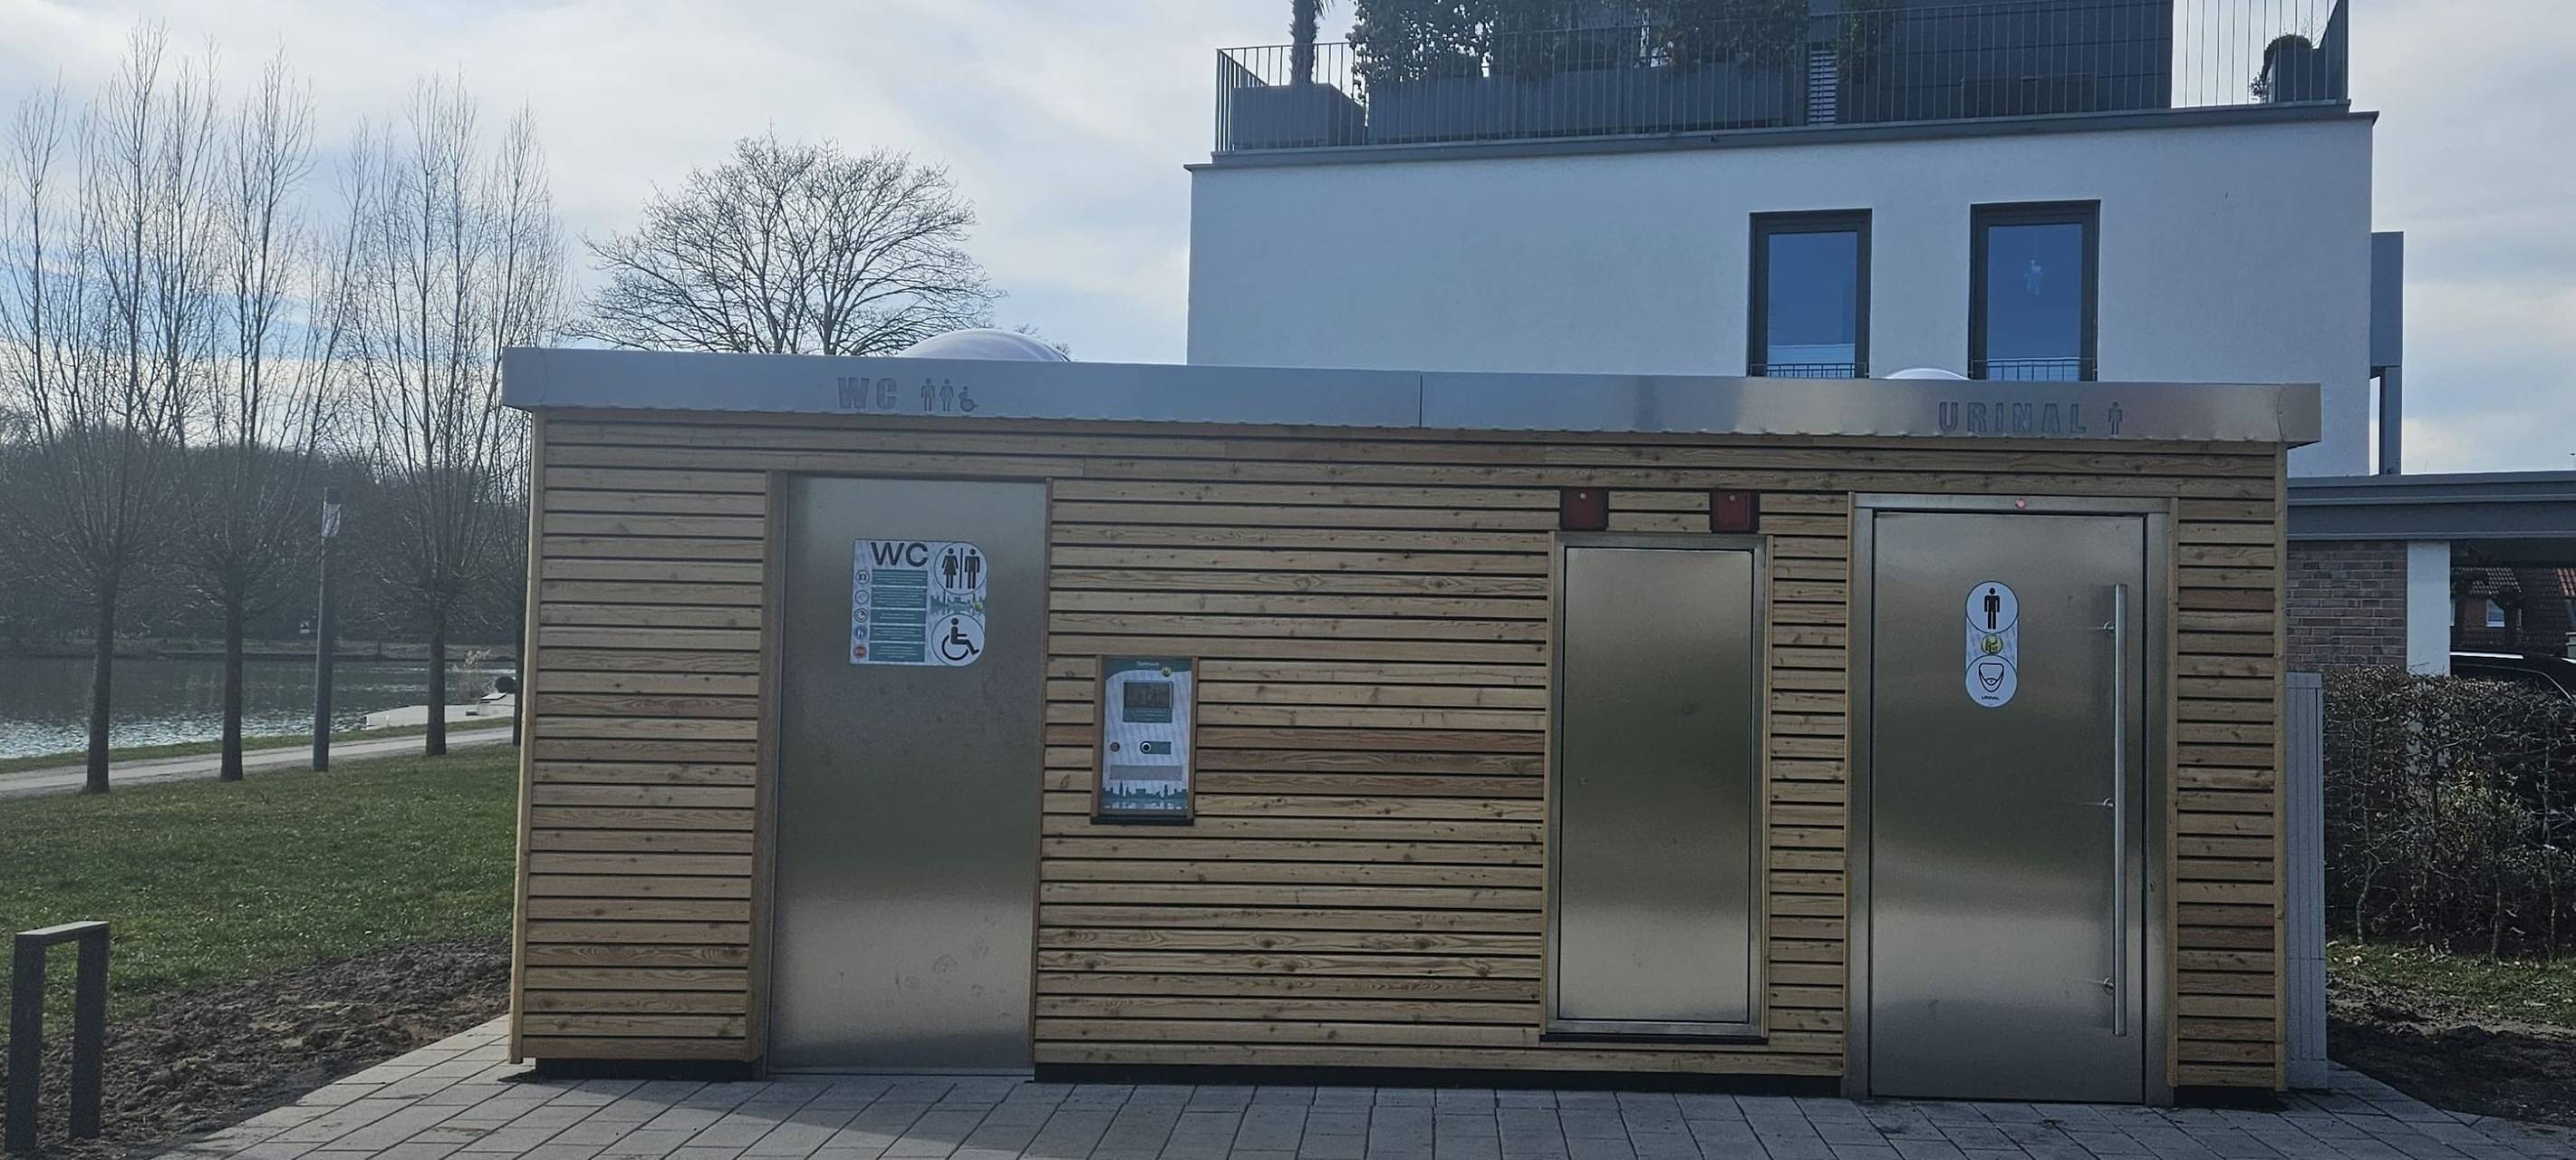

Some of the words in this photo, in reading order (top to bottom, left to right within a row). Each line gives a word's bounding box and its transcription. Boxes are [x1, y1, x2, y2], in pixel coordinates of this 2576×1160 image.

[837, 377, 897, 409] WC
[1939, 401, 2088, 433] URINAL
[871, 542, 929, 567] WC
